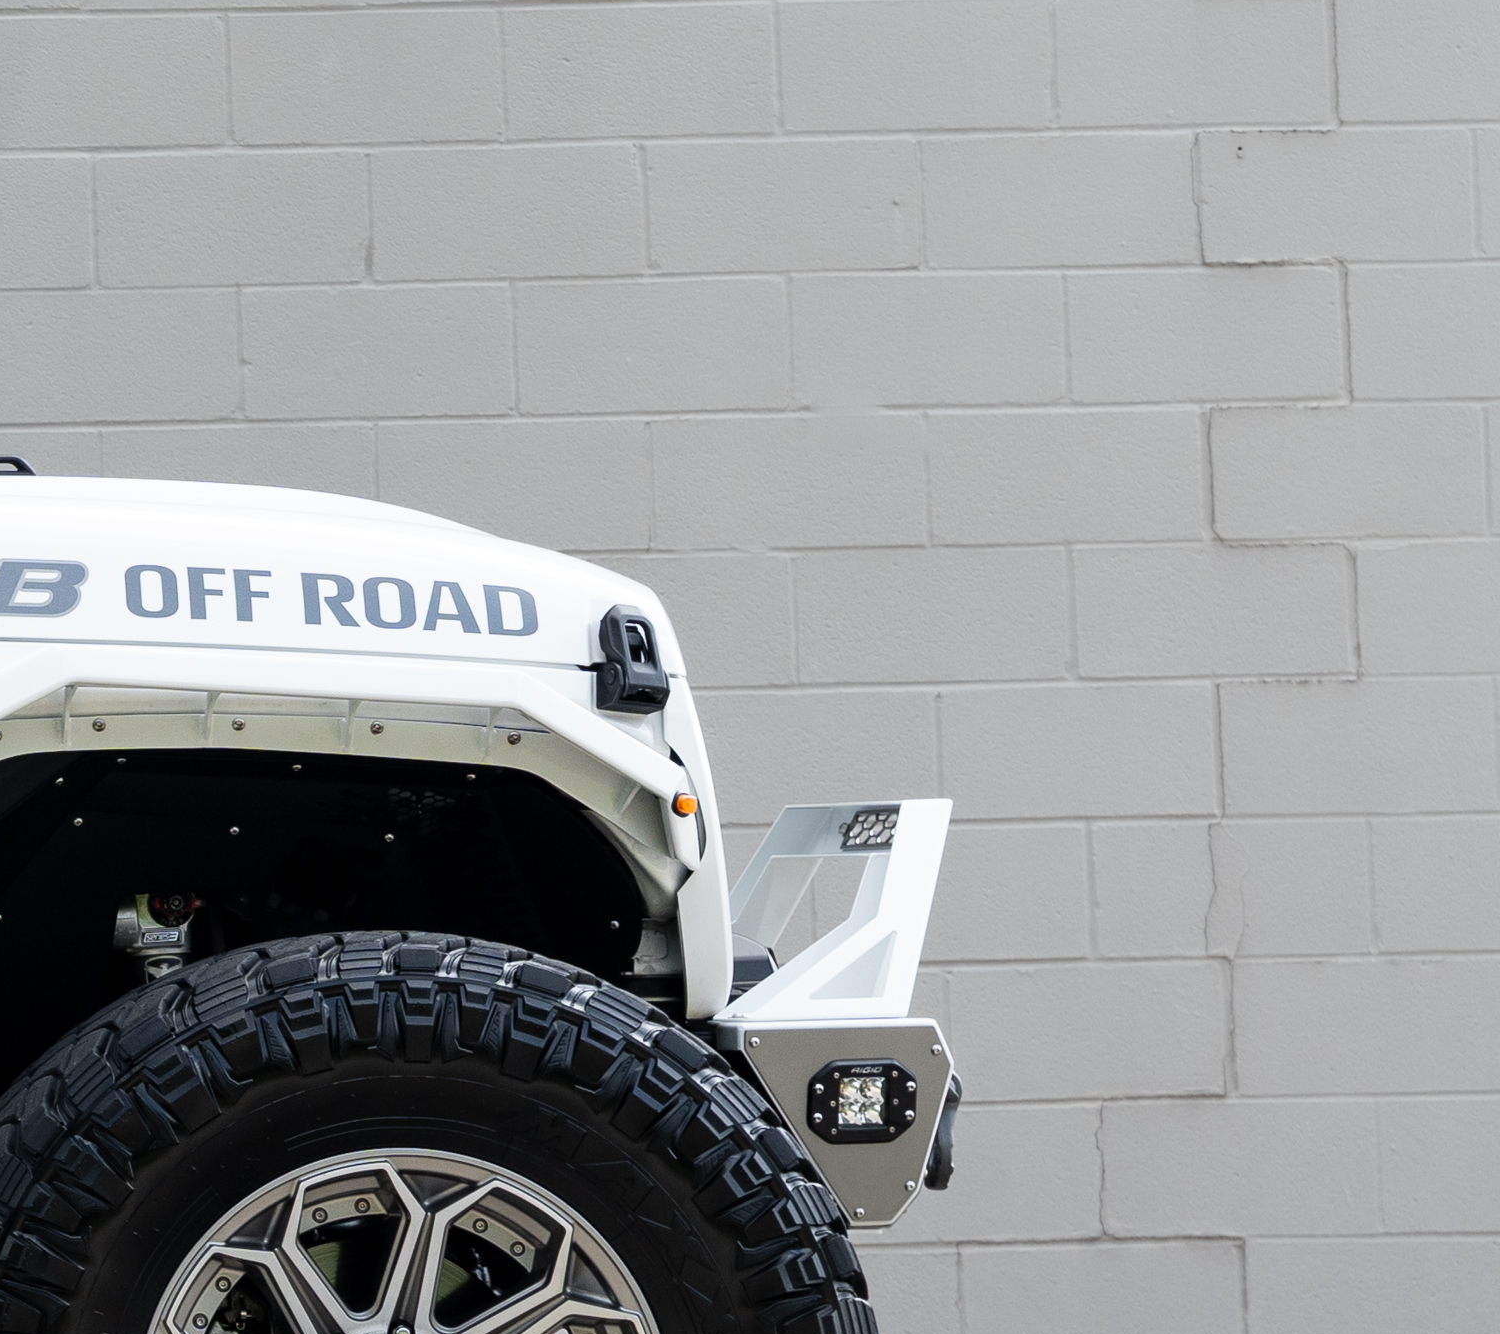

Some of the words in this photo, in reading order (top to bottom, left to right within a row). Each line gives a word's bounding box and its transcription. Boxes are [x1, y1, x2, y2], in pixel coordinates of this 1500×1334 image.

[125, 565, 271, 622] OFF
[301, 573, 538, 636] ROAD
[850, 1066, 883, 1074] RIGID
